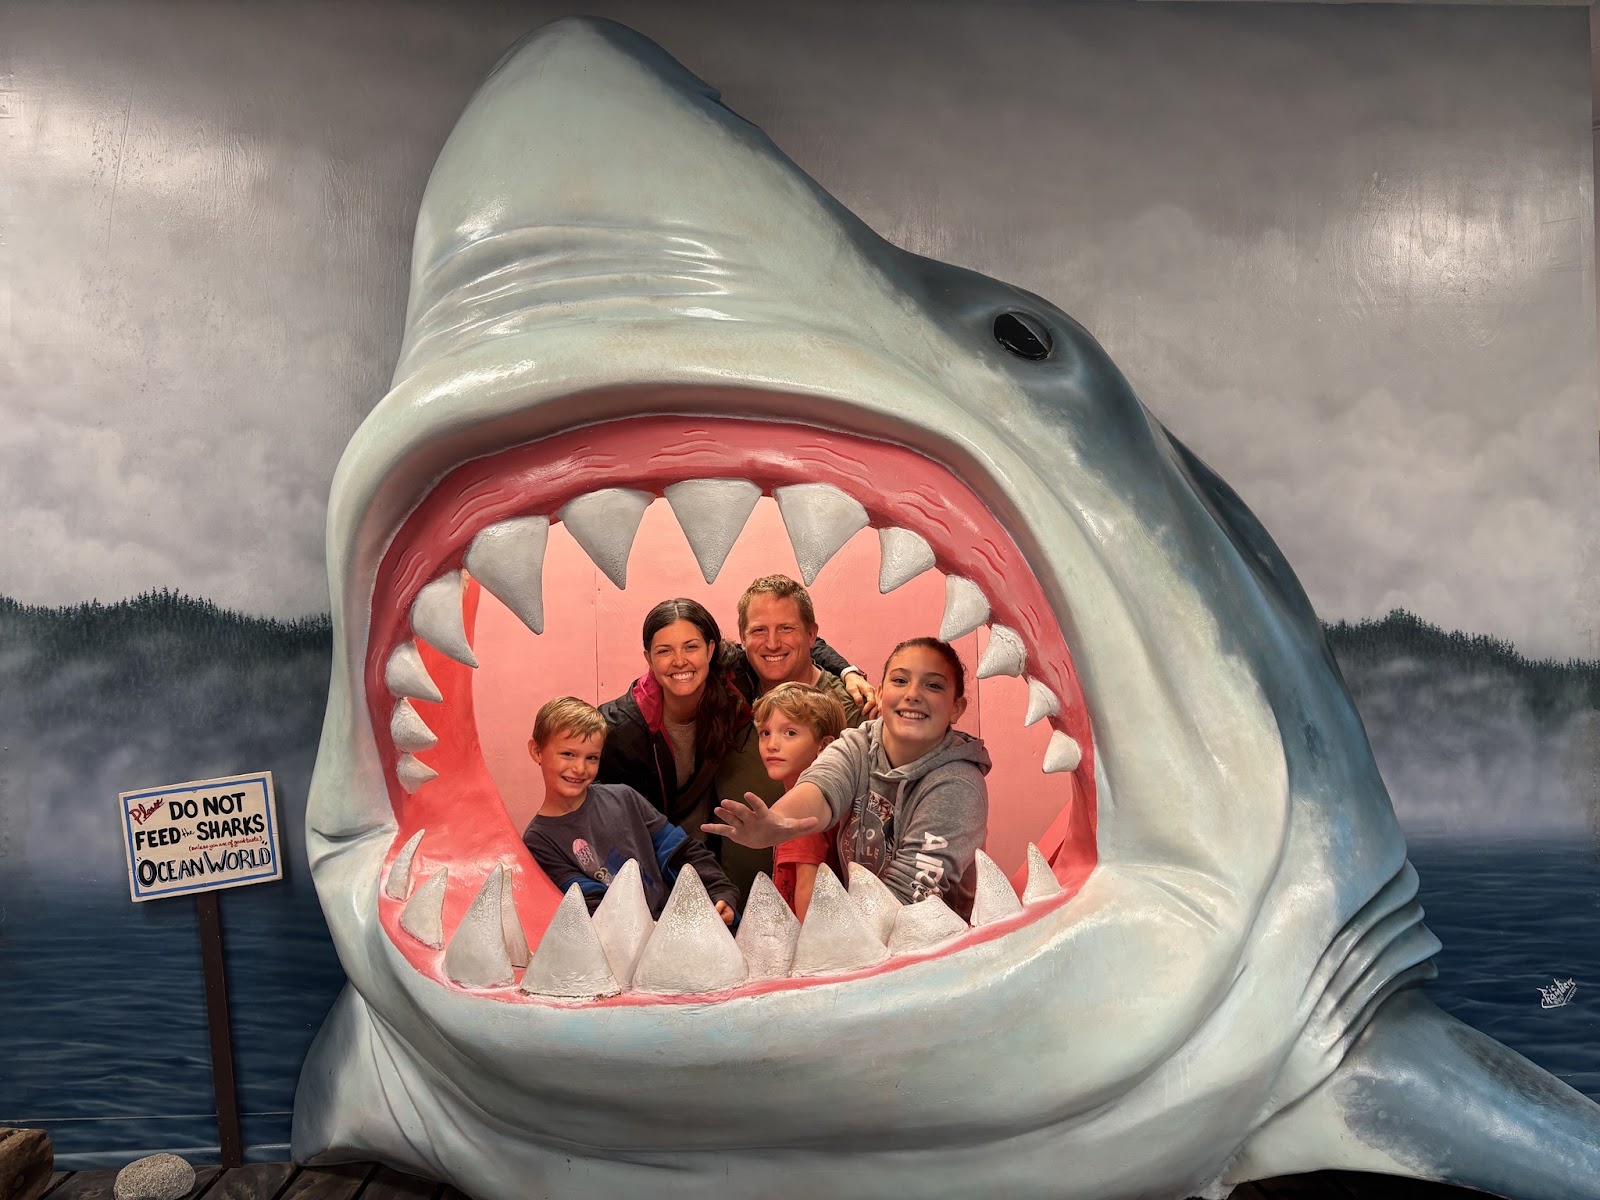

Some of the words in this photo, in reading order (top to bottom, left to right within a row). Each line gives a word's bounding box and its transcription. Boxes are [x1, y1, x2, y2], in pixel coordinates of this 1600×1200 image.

[169, 800, 198, 820] DO
[203, 792, 245, 816] NOT
[135, 827, 181, 850] FEED
[181, 827, 195, 838] the
[196, 813, 265, 841] SHARKS
